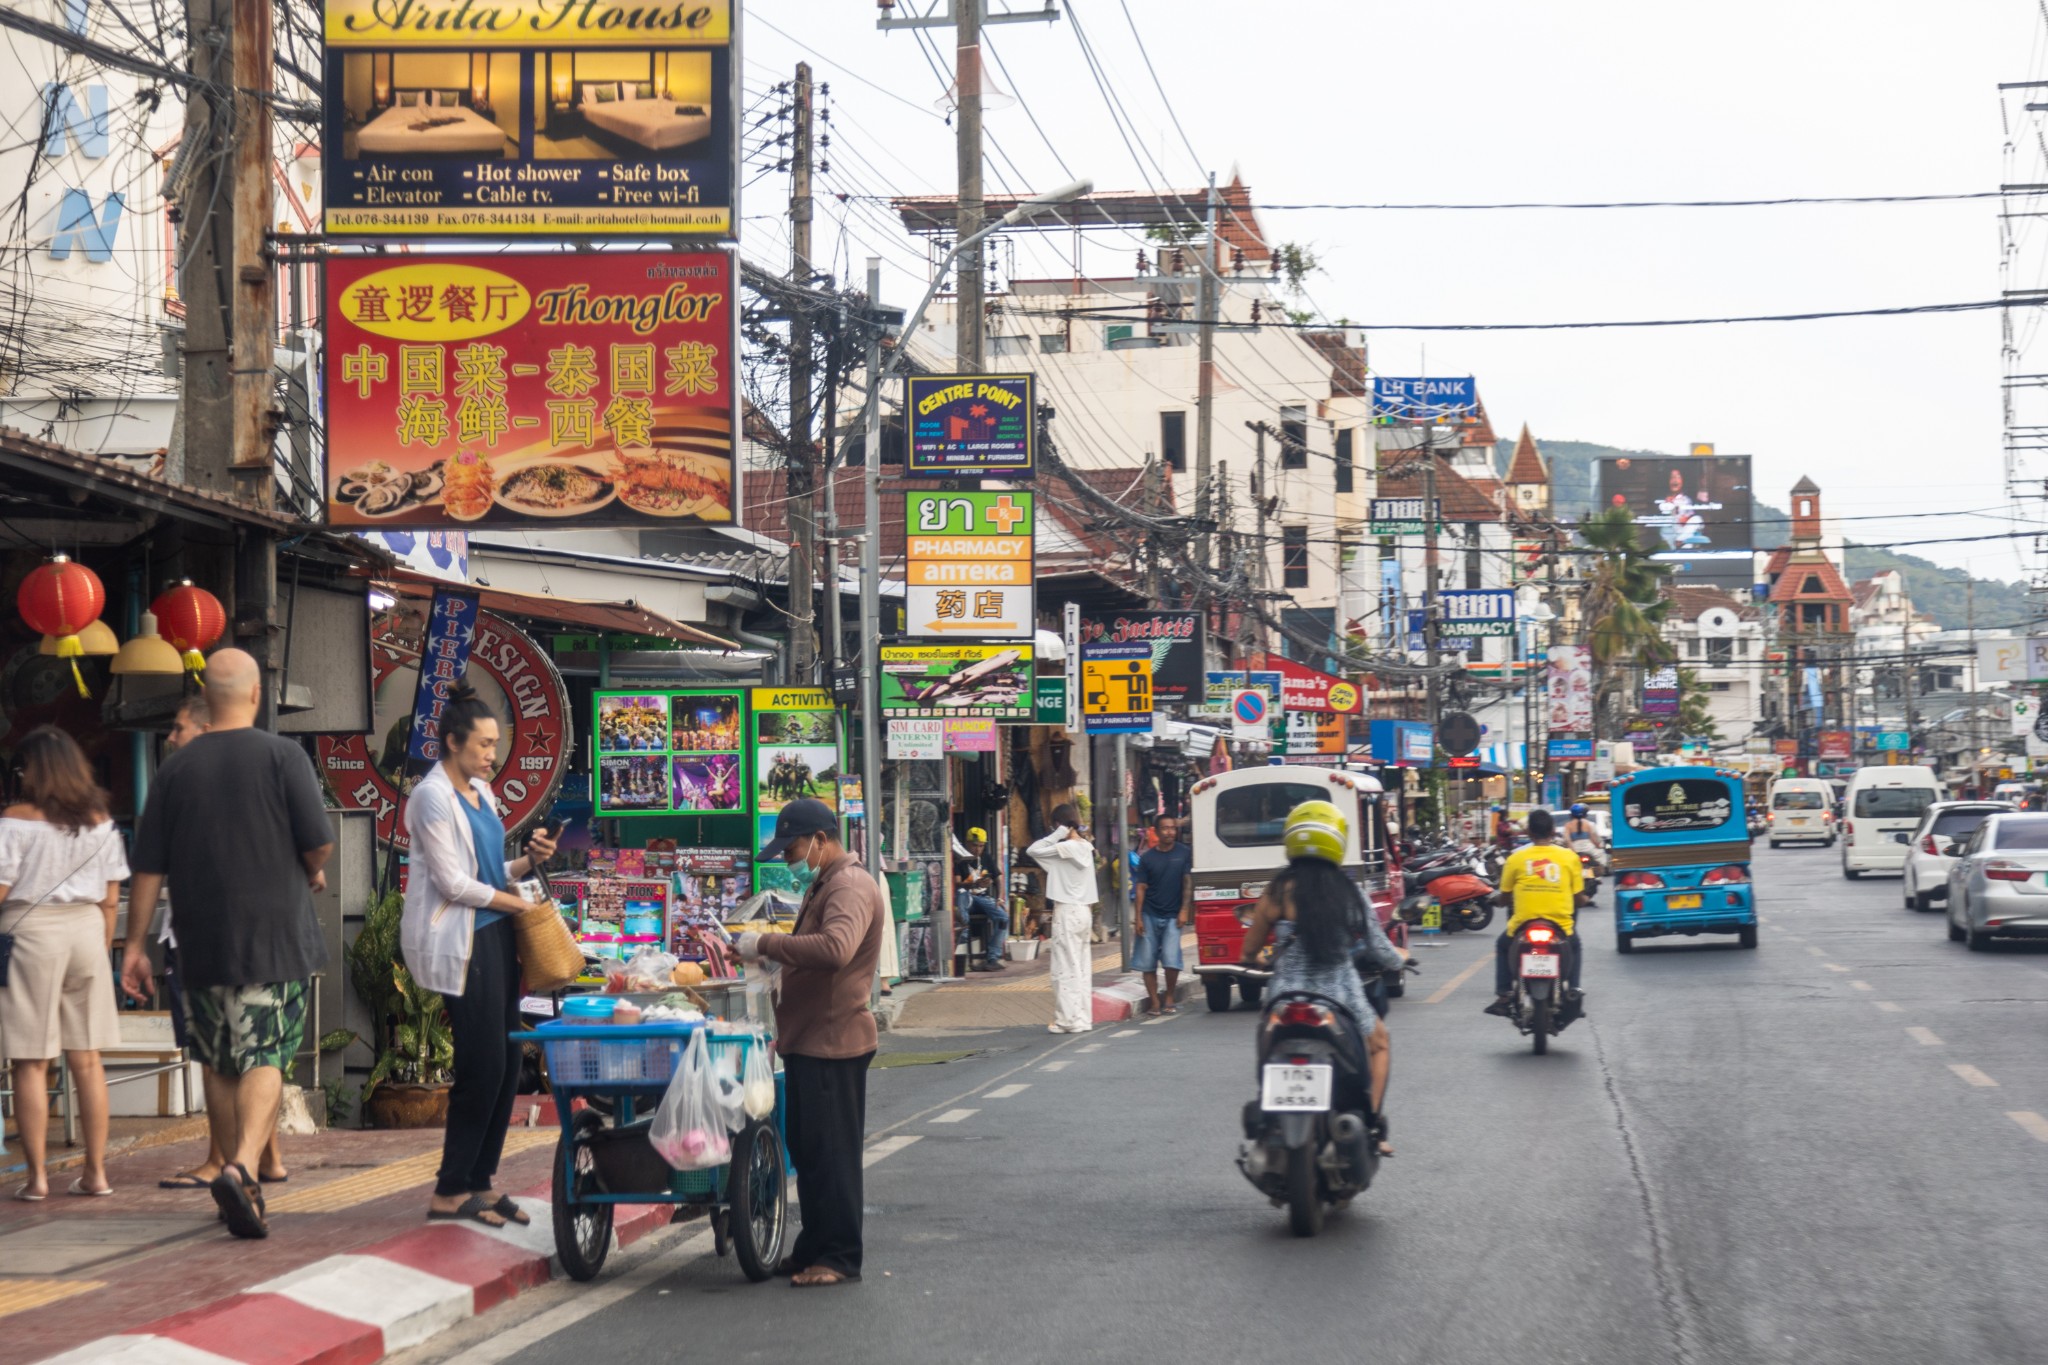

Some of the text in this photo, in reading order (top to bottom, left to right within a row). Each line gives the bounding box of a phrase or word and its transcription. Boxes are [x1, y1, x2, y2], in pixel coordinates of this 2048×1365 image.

[346, 0, 713, 31] Arita House
[401, 168, 433, 182] con
[517, 164, 581, 182] shower
[656, 164, 690, 182] box
[658, 186, 700, 204] wi-fi
[537, 283, 722, 335] Thonglor
[1413, 381, 1466, 396] BANK
[918, 383, 1022, 415] CENTRE POINT
[946, 443, 957, 451] AC
[919, 496, 975, 532] ยา
[913, 540, 1024, 556] PHARMACY
[924, 561, 1015, 582] аптека
[935, 590, 1006, 619] 药店
[1440, 622, 1513, 636] ARMACY
[421, 598, 466, 761] PIERCING
[471, 629, 550, 720] ESIGN
[1283, 676, 1329, 690] ama's
[772, 693, 830, 706] ACTIVITY
[1284, 694, 1326, 707] tchen
[890, 721, 940, 733] SIM CARD
[945, 720, 993, 733] LAUNDRY
[891, 733, 940, 741] INTERNET
[326, 756, 366, 770] Since
[519, 756, 554, 770] 1997
[600, 758, 630, 767] SIMON
[352, 779, 397, 821] BY
[551, 885, 578, 896] TOUR
